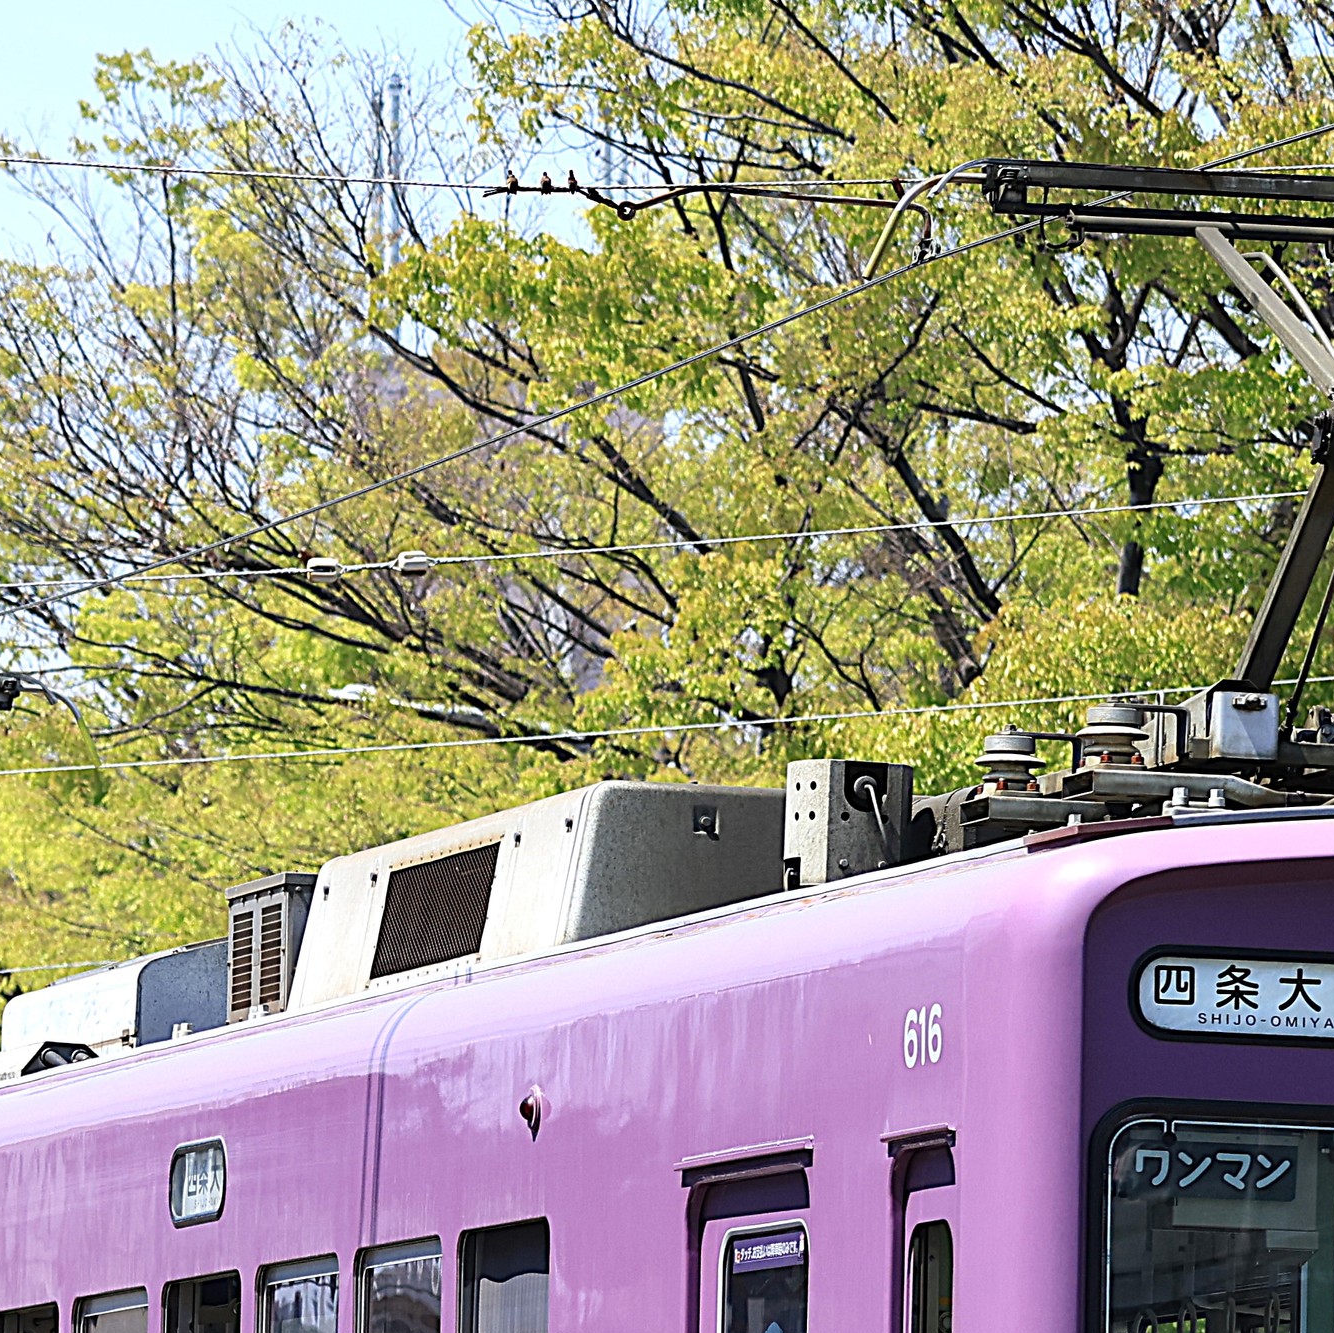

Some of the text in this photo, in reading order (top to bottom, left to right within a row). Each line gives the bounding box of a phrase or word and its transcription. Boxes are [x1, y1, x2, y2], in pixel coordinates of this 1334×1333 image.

[903, 1003, 942, 1069] 616
[1198, 1012, 1334, 1029] SHIJO-OMIYA
[1135, 1149, 1291, 1190] ワンマン
